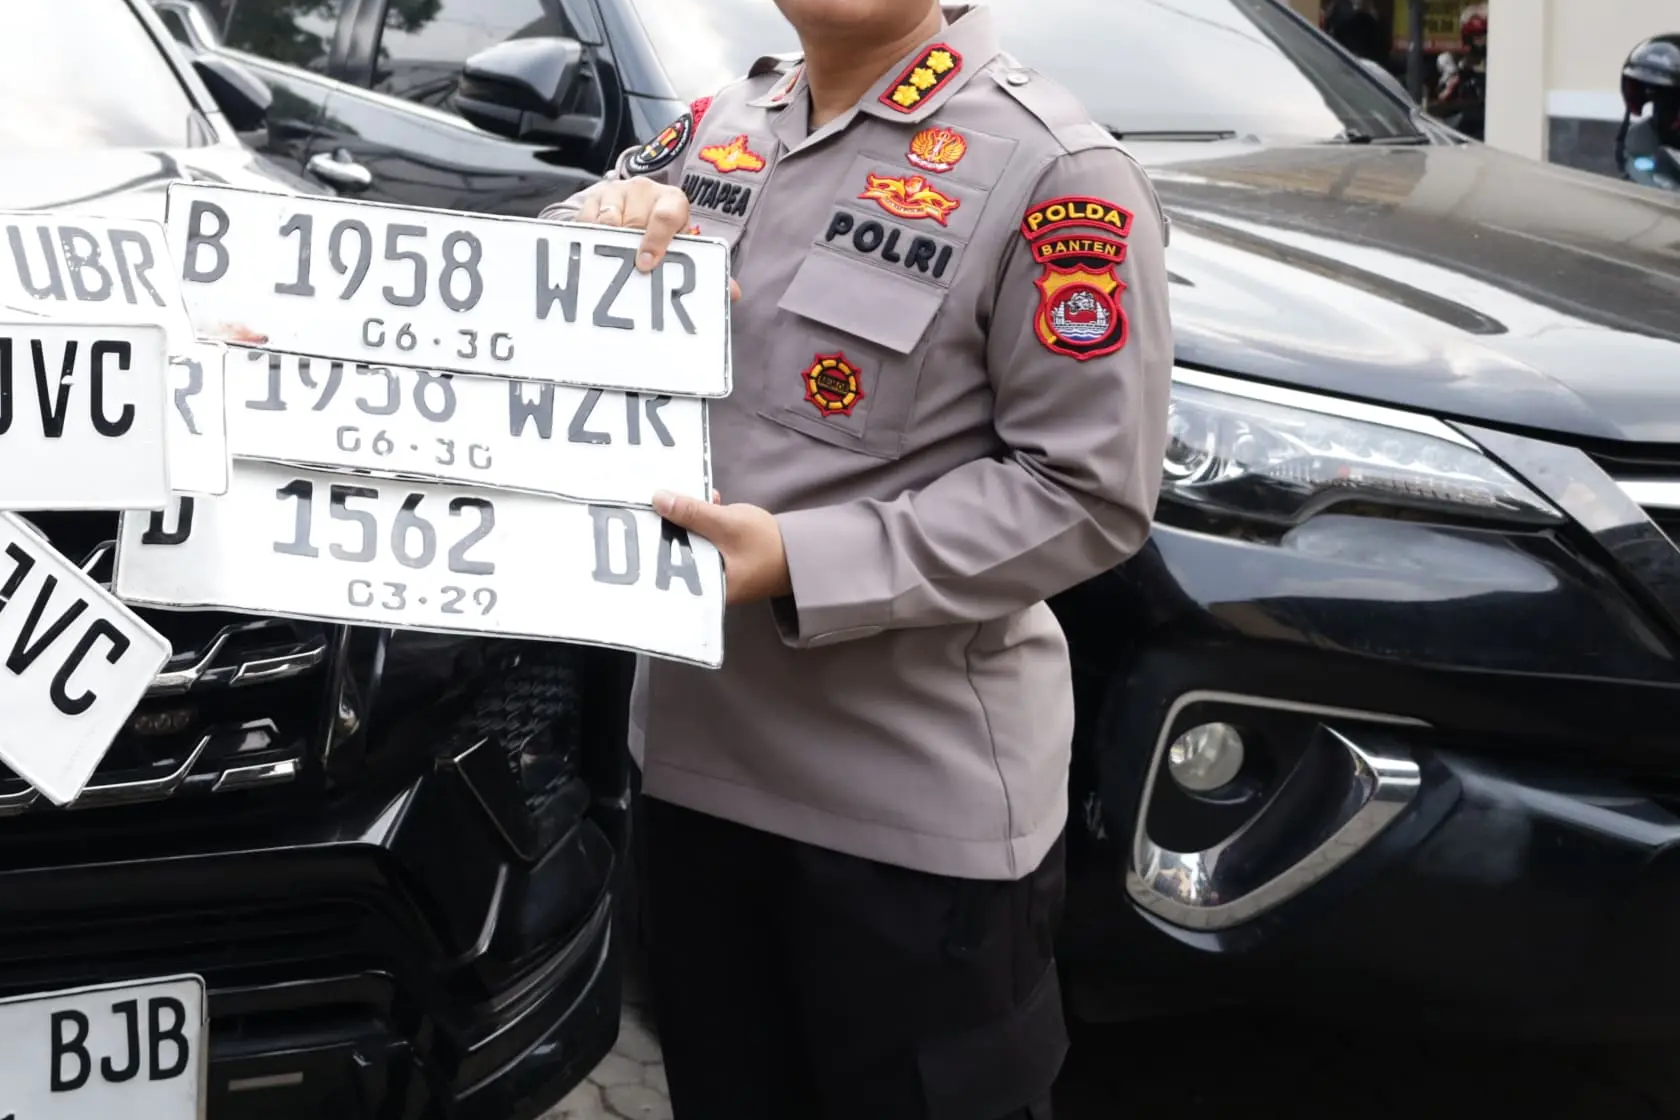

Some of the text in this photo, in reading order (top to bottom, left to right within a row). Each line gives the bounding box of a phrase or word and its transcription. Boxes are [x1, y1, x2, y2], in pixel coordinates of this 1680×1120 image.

[825, 211, 954, 279] POLRI
[1027, 202, 1123, 232] POLDA
[1040, 239, 1117, 257] BANTEN
[6, 224, 166, 307] UBR
[182, 199, 697, 336] B 1958 WZR
[509, 377, 676, 447] WZR
[272, 479, 496, 577] 1562
[587, 504, 704, 597] DA
[51, 997, 190, 1093] BJB
